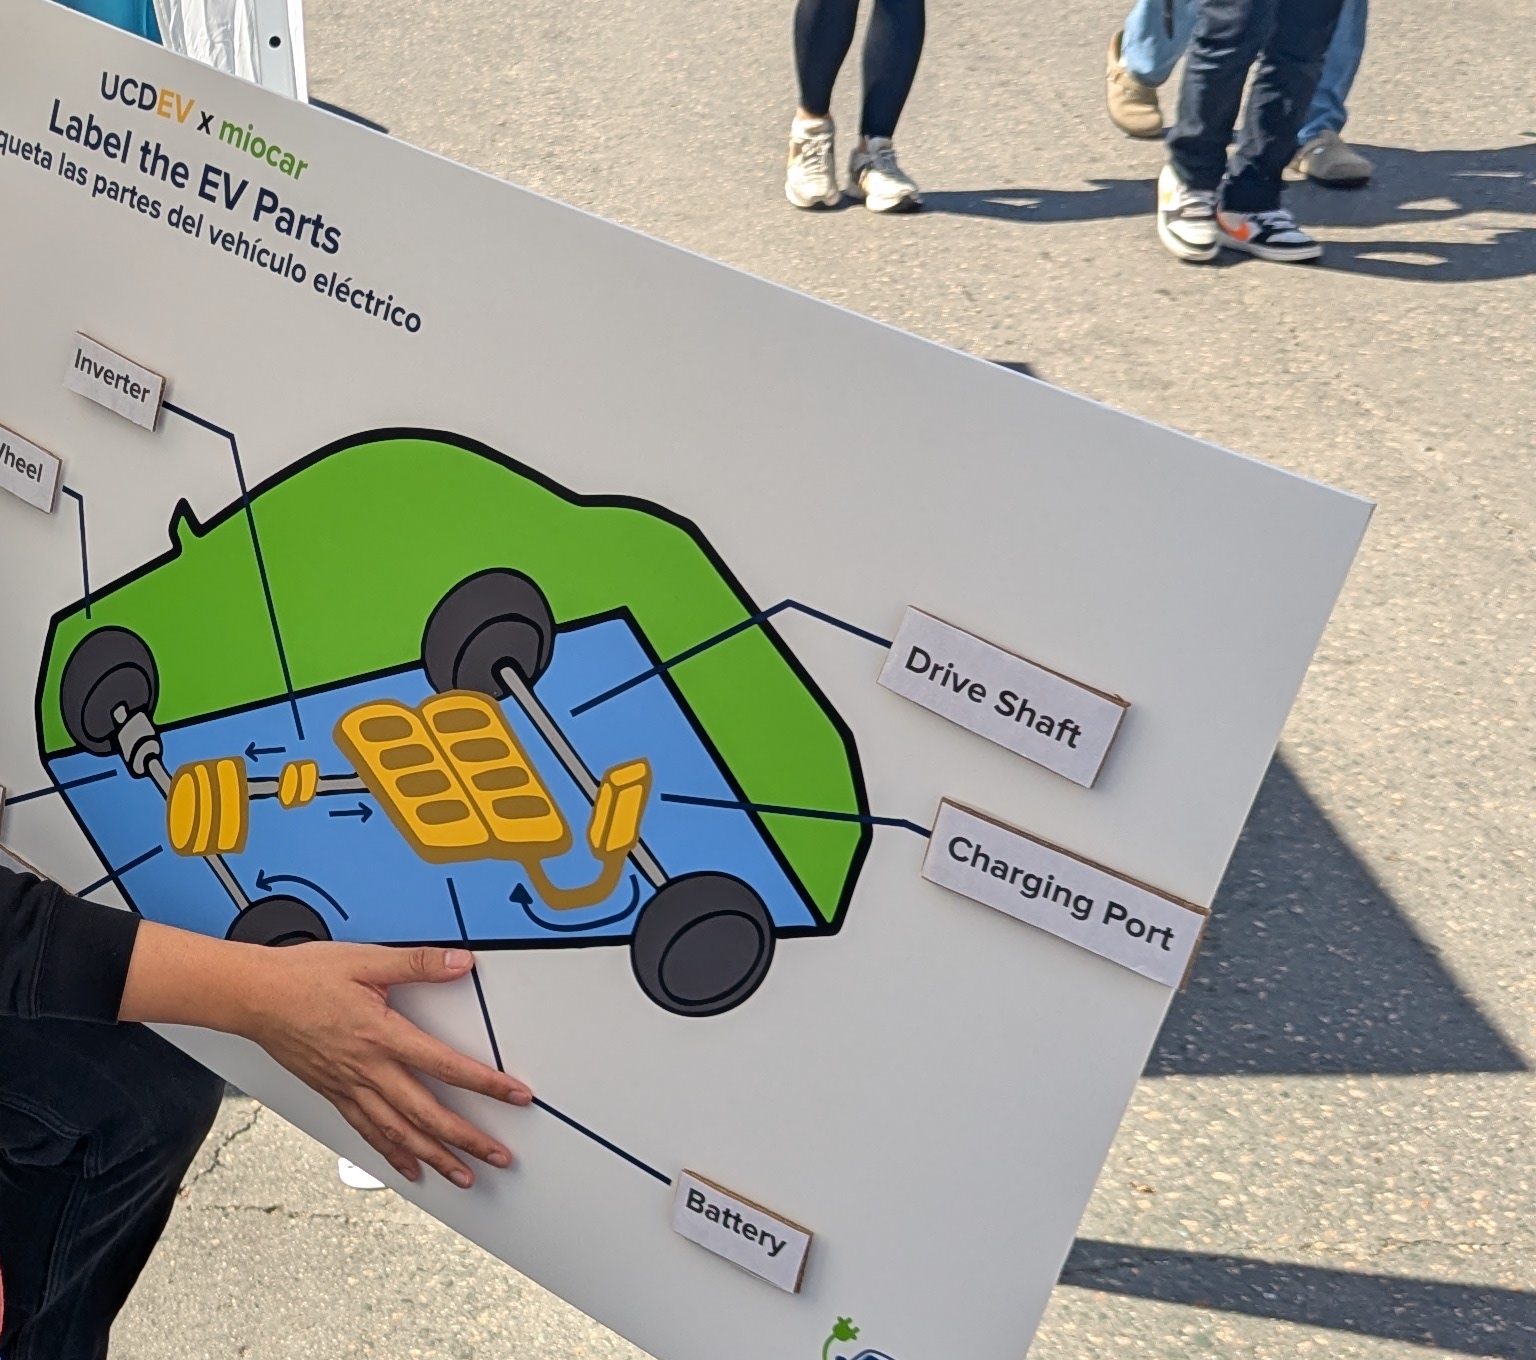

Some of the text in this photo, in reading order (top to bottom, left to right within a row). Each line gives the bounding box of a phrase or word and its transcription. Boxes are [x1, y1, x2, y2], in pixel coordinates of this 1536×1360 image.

[101, 70, 195, 124] UCDEV
[196, 111, 215, 136] x
[48, 98, 342, 254] Label the EV Parts
[59, 153, 87, 187] las
[92, 169, 161, 219] partes
[167, 201, 202, 239] del
[209, 225, 306, 284] vehículo
[313, 263, 421, 333] eléctrico
[73, 348, 151, 403] Inverter
[904, 646, 1082, 749] Drive Shaft
[948, 836, 1175, 952] Charging Port
[685, 1187, 786, 1258] Battery
